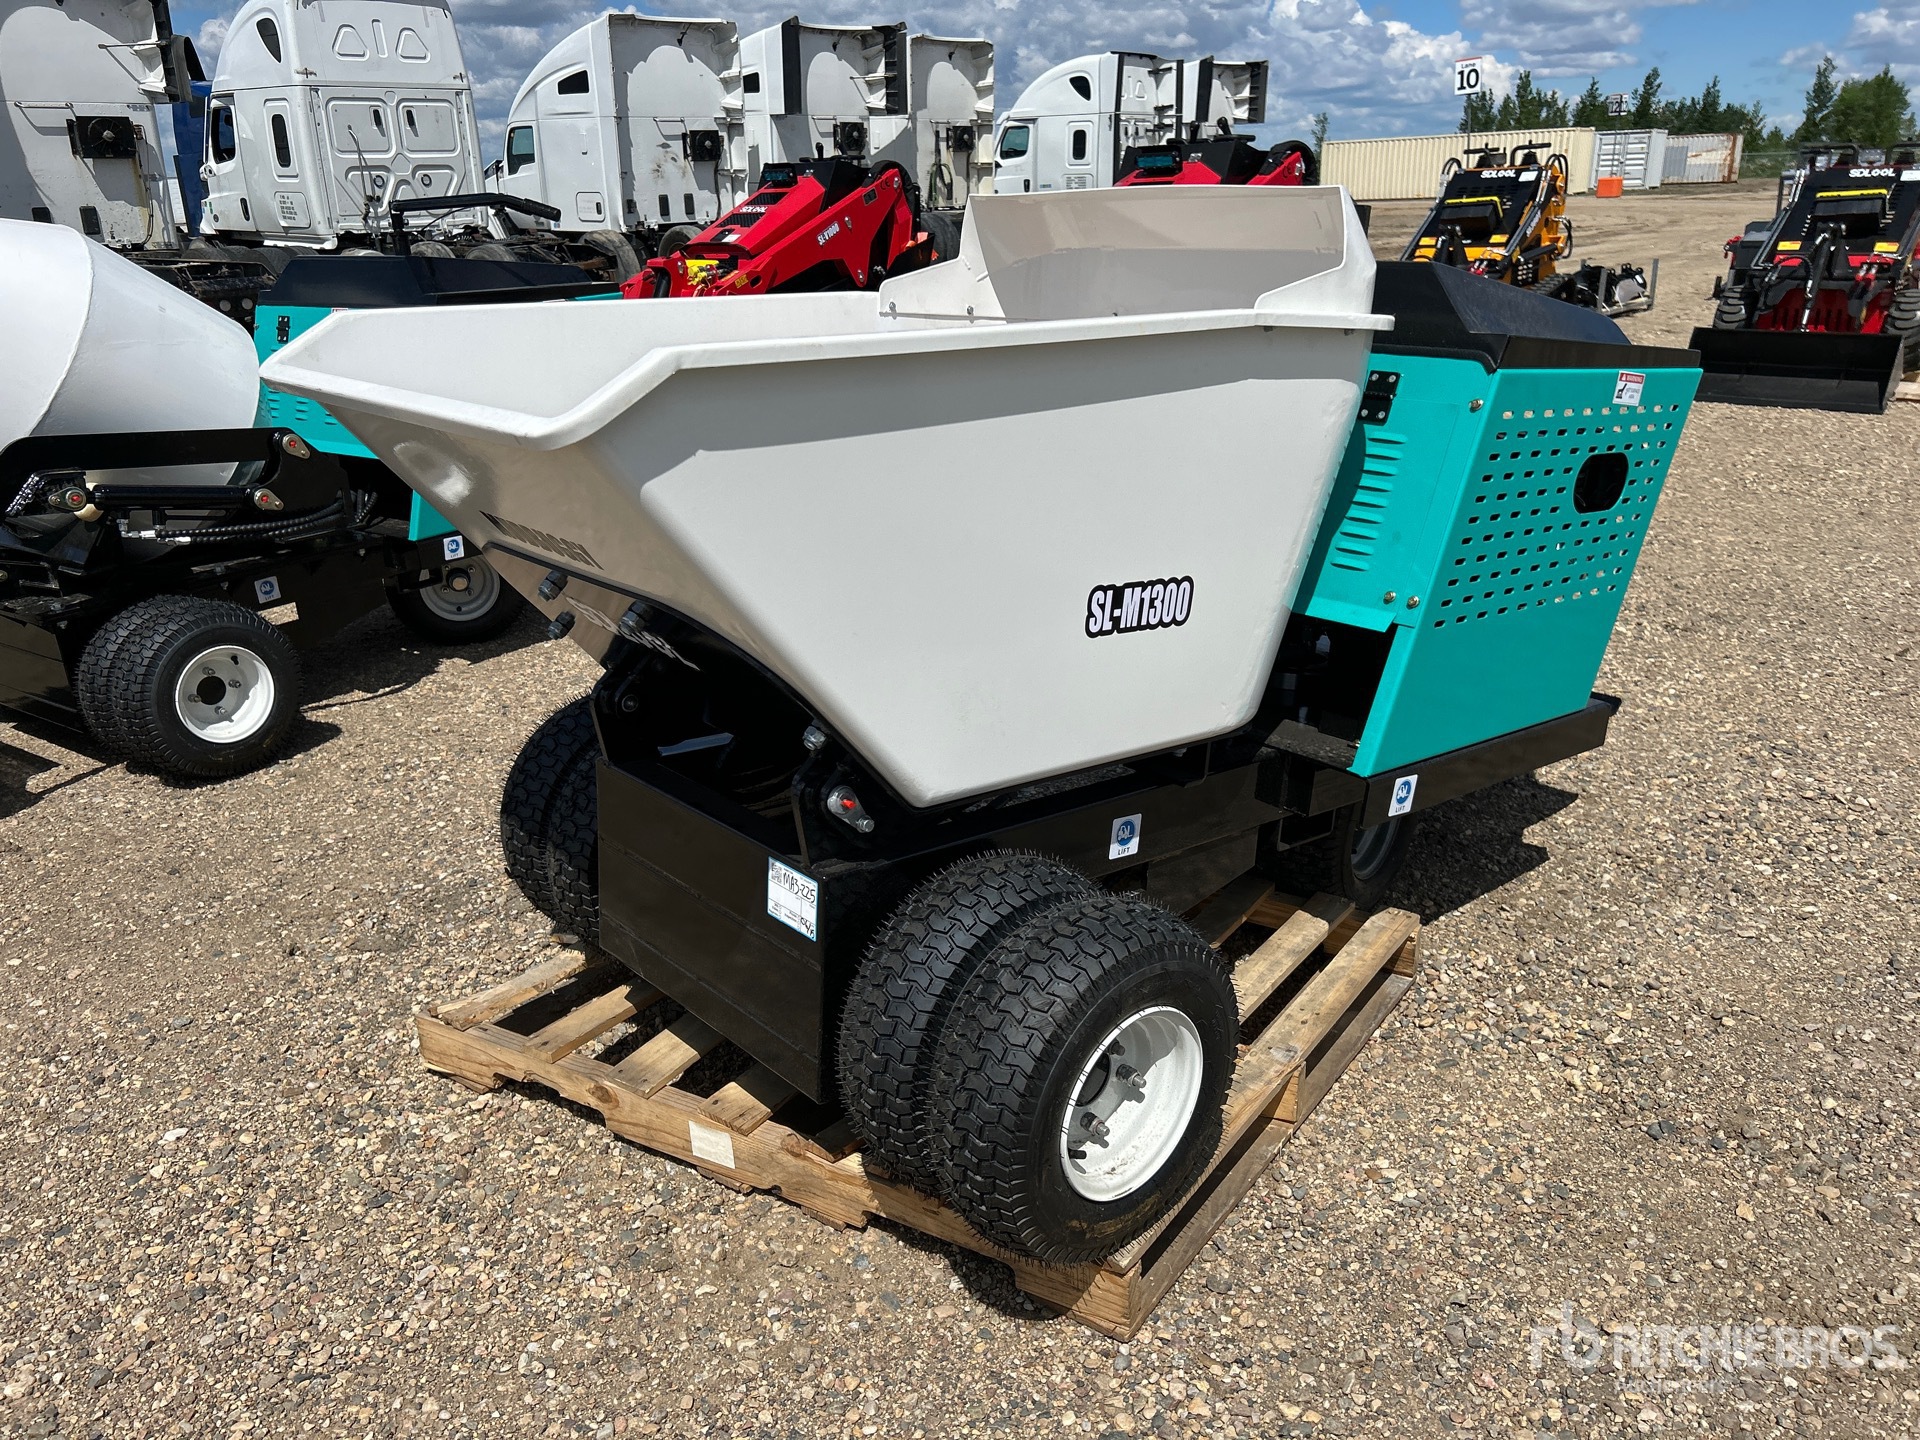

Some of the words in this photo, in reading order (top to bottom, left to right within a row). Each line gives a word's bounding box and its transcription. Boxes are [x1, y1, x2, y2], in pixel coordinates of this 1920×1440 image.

[1457, 68, 1480, 91] 10
[1848, 167, 1896, 178] SDLOOL
[1087, 579, 1192, 634] SL-M1300
[1117, 846, 1131, 856] LIFT
